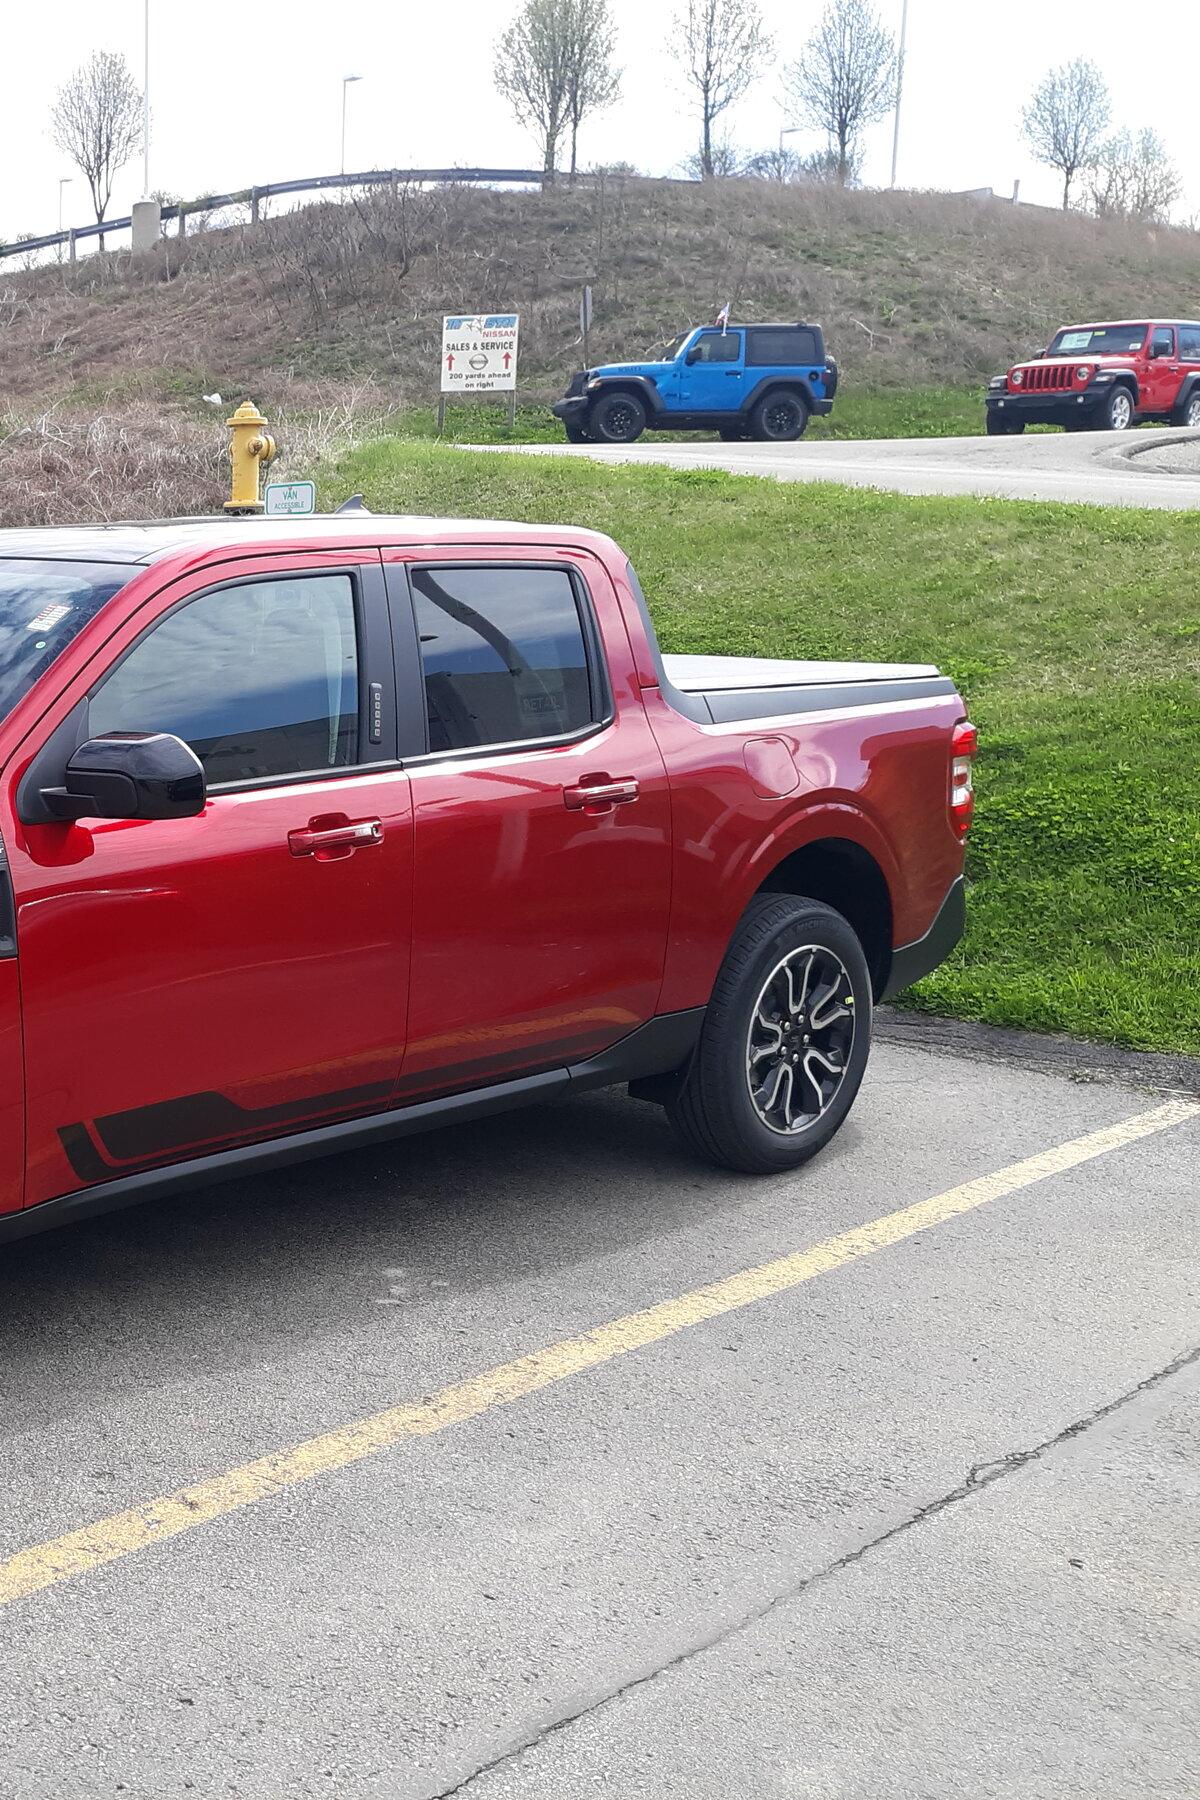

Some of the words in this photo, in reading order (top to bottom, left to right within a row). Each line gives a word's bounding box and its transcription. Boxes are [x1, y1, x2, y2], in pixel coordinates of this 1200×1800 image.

[482, 330, 516, 338] NISSAN
[446, 342, 470, 351] SALES
[472, 342, 478, 351] &
[480, 341, 514, 351] SERVICE
[465, 372, 486, 380] yards
[282, 490, 298, 500] VAN
[274, 501, 305, 510] ACCESSIBLE
